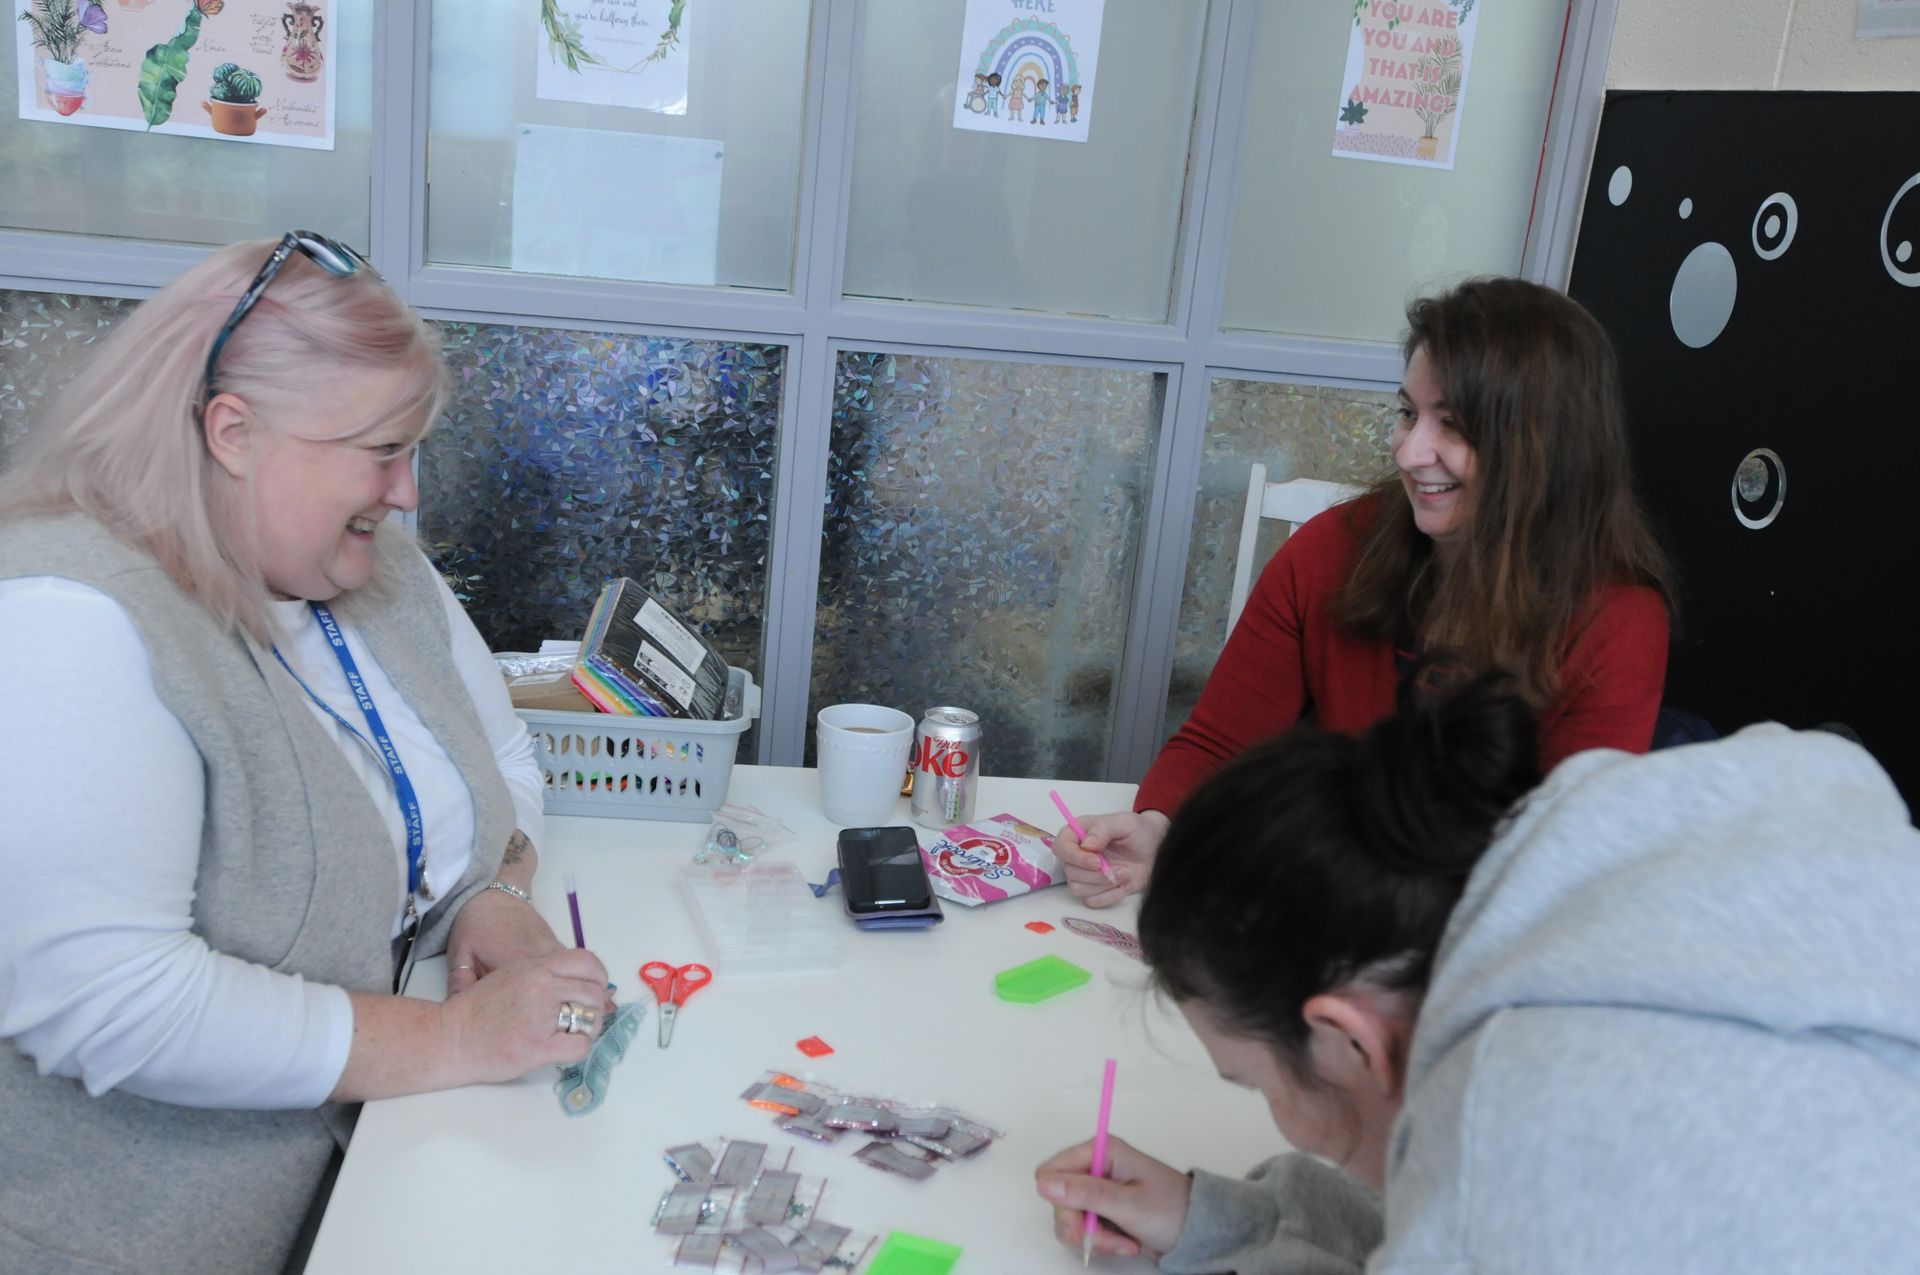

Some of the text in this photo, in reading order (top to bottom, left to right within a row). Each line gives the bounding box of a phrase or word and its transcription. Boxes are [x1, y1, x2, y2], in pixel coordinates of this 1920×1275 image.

[1369, 0, 1458, 29] YOU ARE
[1363, 27, 1457, 57] YOU AND
[1369, 57, 1441, 83] THAT IS
[318, 609, 343, 647] STAFF
[347, 671, 372, 710] STAFF
[378, 736, 403, 775] STAFF
[932, 735, 962, 750] Diet
[408, 802, 421, 846] STAFF
[930, 839, 1013, 880] Seabrook
